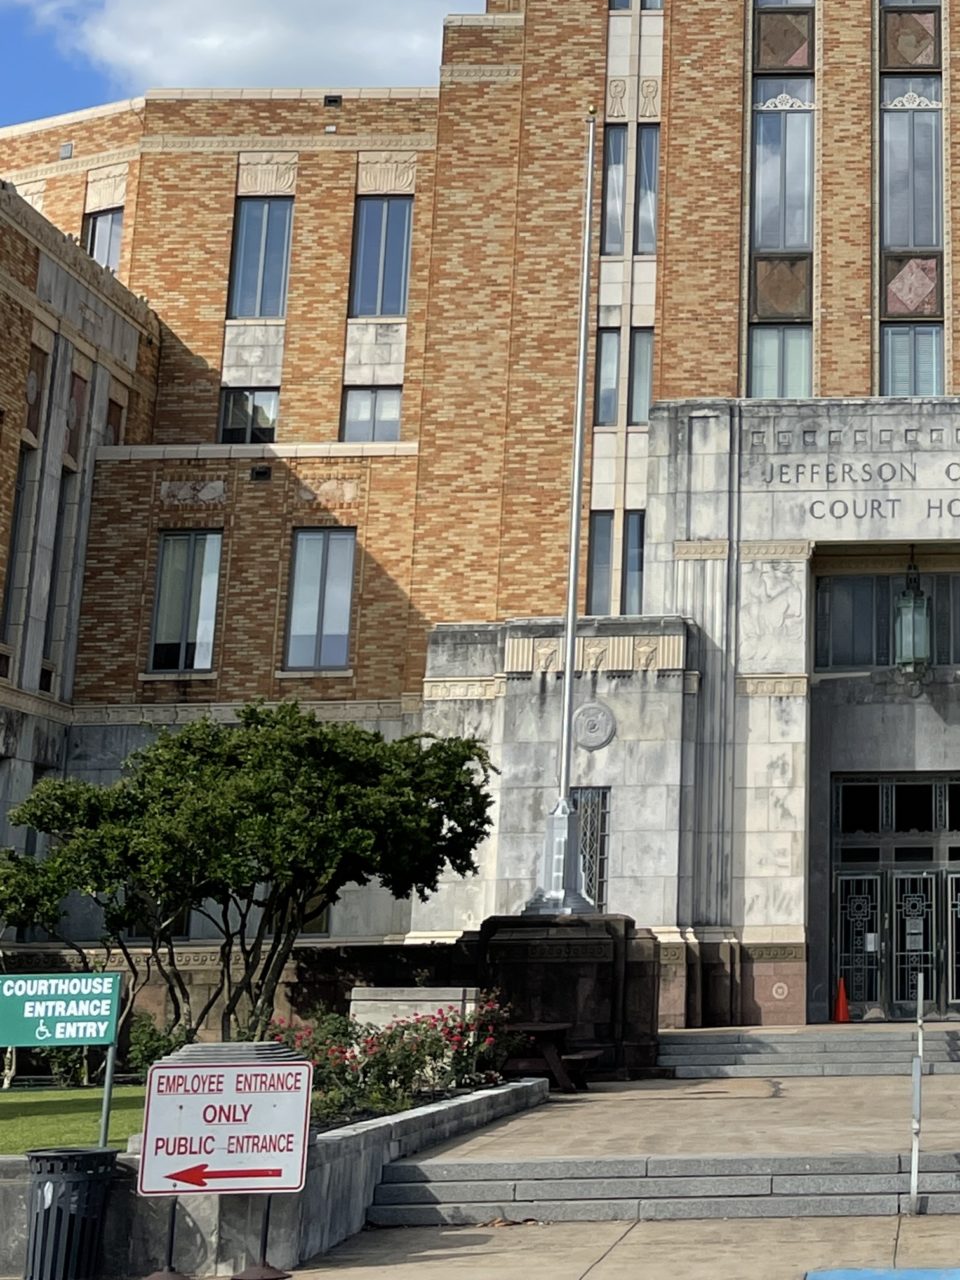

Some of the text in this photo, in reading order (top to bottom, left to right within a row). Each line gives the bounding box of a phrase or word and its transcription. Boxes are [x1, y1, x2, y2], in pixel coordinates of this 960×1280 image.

[765, 462, 916, 484] JEFFERSON
[810, 499, 901, 520] COURT
[3, 978, 113, 996] COURTHOUSE
[24, 1000, 111, 1017] ENTRANCE
[55, 1022, 109, 1038] ENTRY
[157, 1072, 302, 1094] EMPLOYEE ENTRANCE
[203, 1104, 252, 1123] ONLY
[155, 1134, 294, 1156] PUBLIC ENTRANCE
